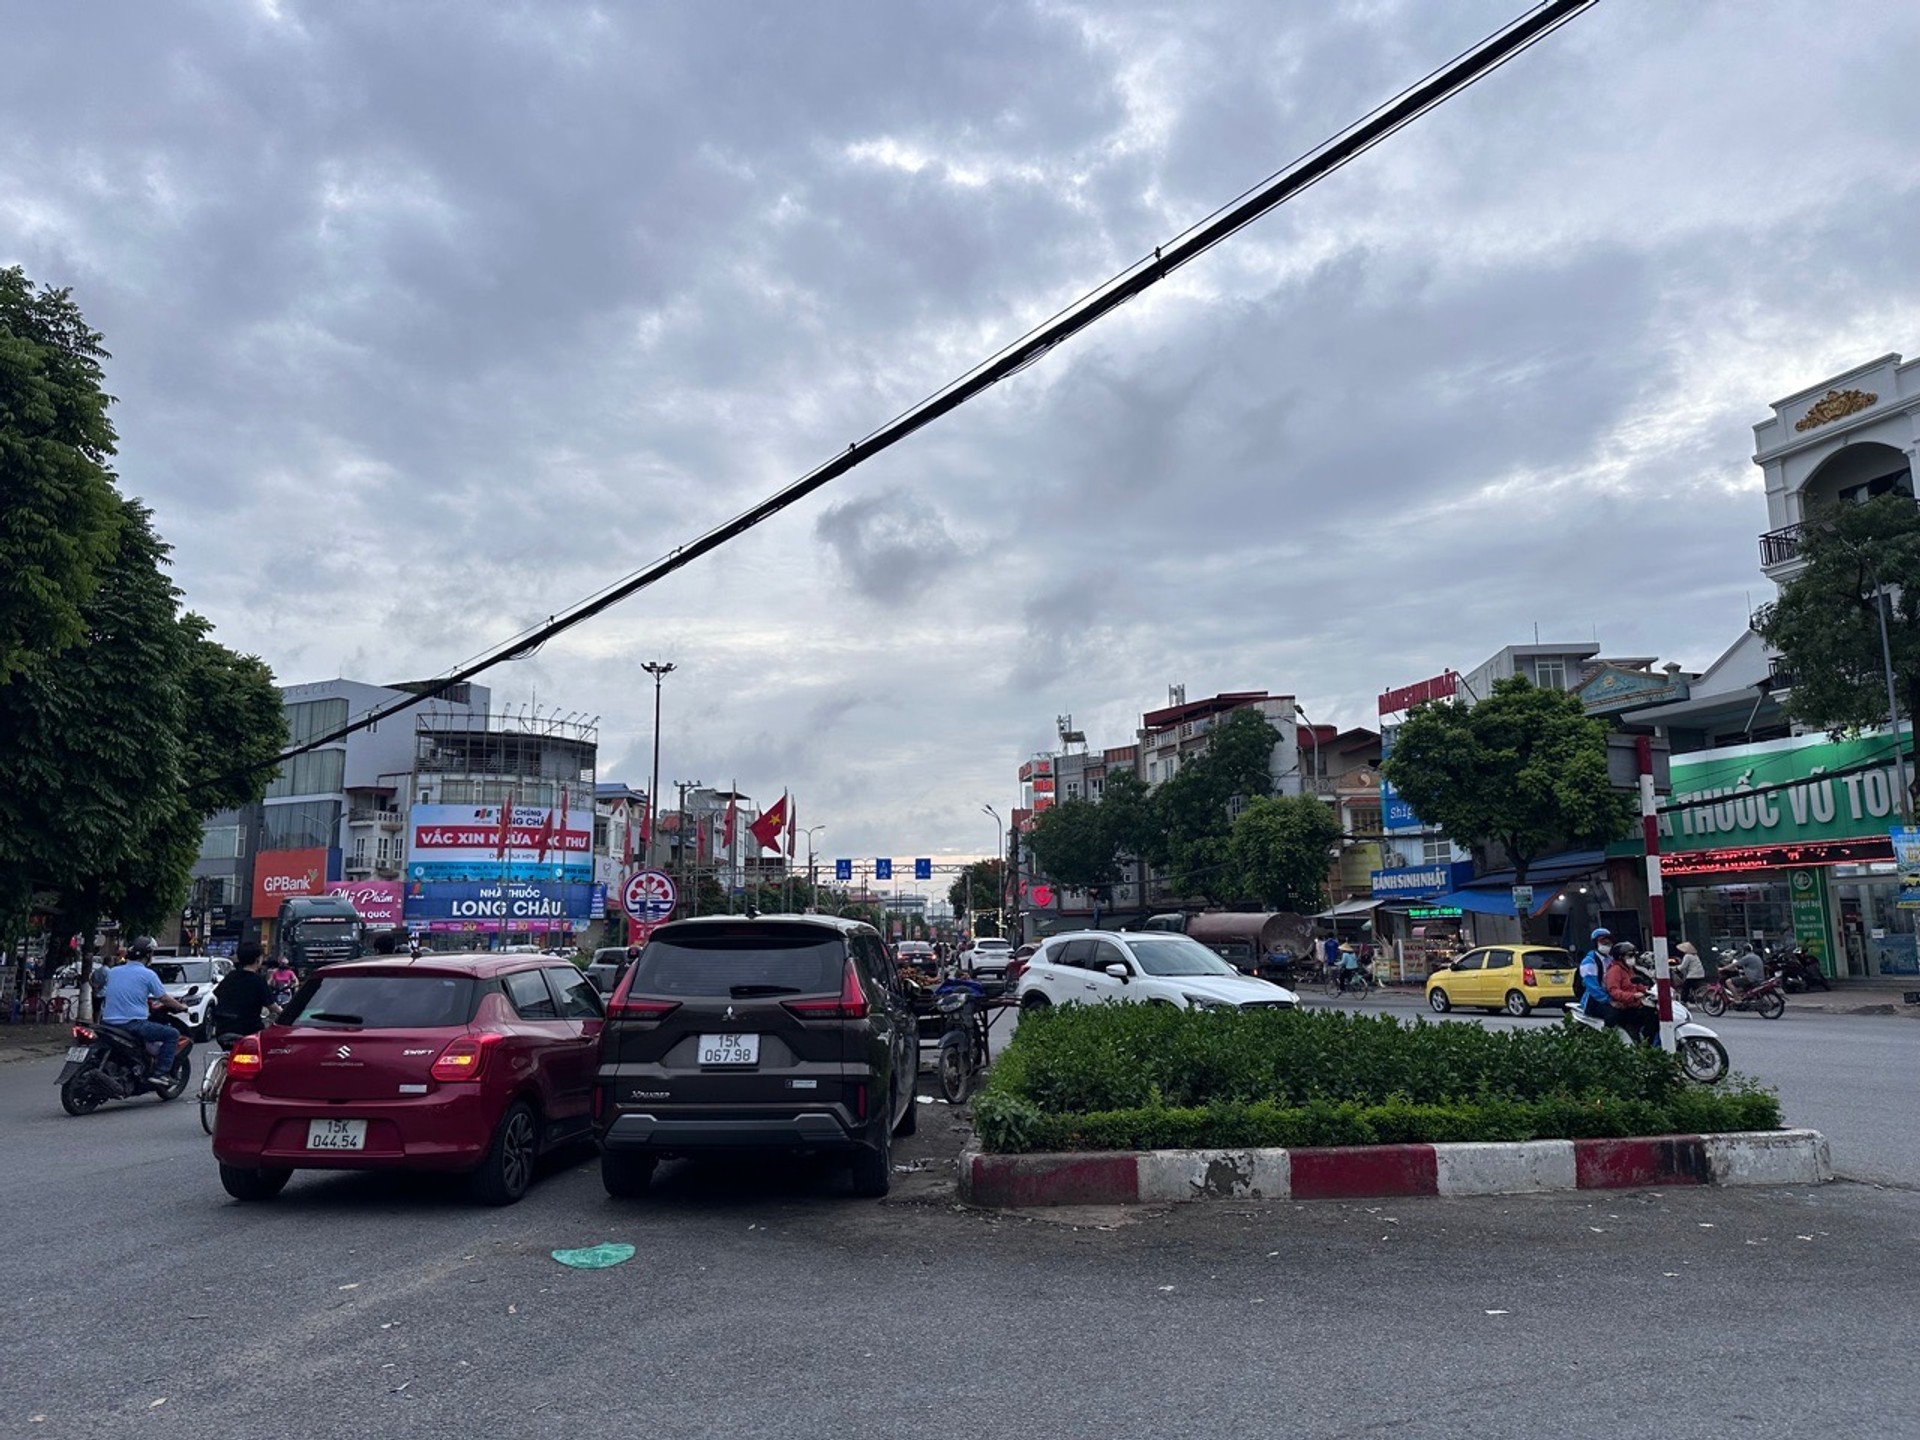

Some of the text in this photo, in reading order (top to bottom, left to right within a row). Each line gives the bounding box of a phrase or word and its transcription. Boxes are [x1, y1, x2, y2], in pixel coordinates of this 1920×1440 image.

[1786, 765, 1836, 825] VŨ
[421, 829, 453, 844] VẮC
[458, 833, 484, 844] XIN
[264, 876, 310, 891] GPBank
[1373, 867, 1446, 890] BÁNH SINH NHẬT
[452, 898, 561, 916] LONG CHÂU
[719, 1034, 741, 1048] 15K
[705, 1048, 751, 1062] 067.98
[327, 1120, 348, 1134] 15K
[313, 1135, 357, 1149] 044.54
